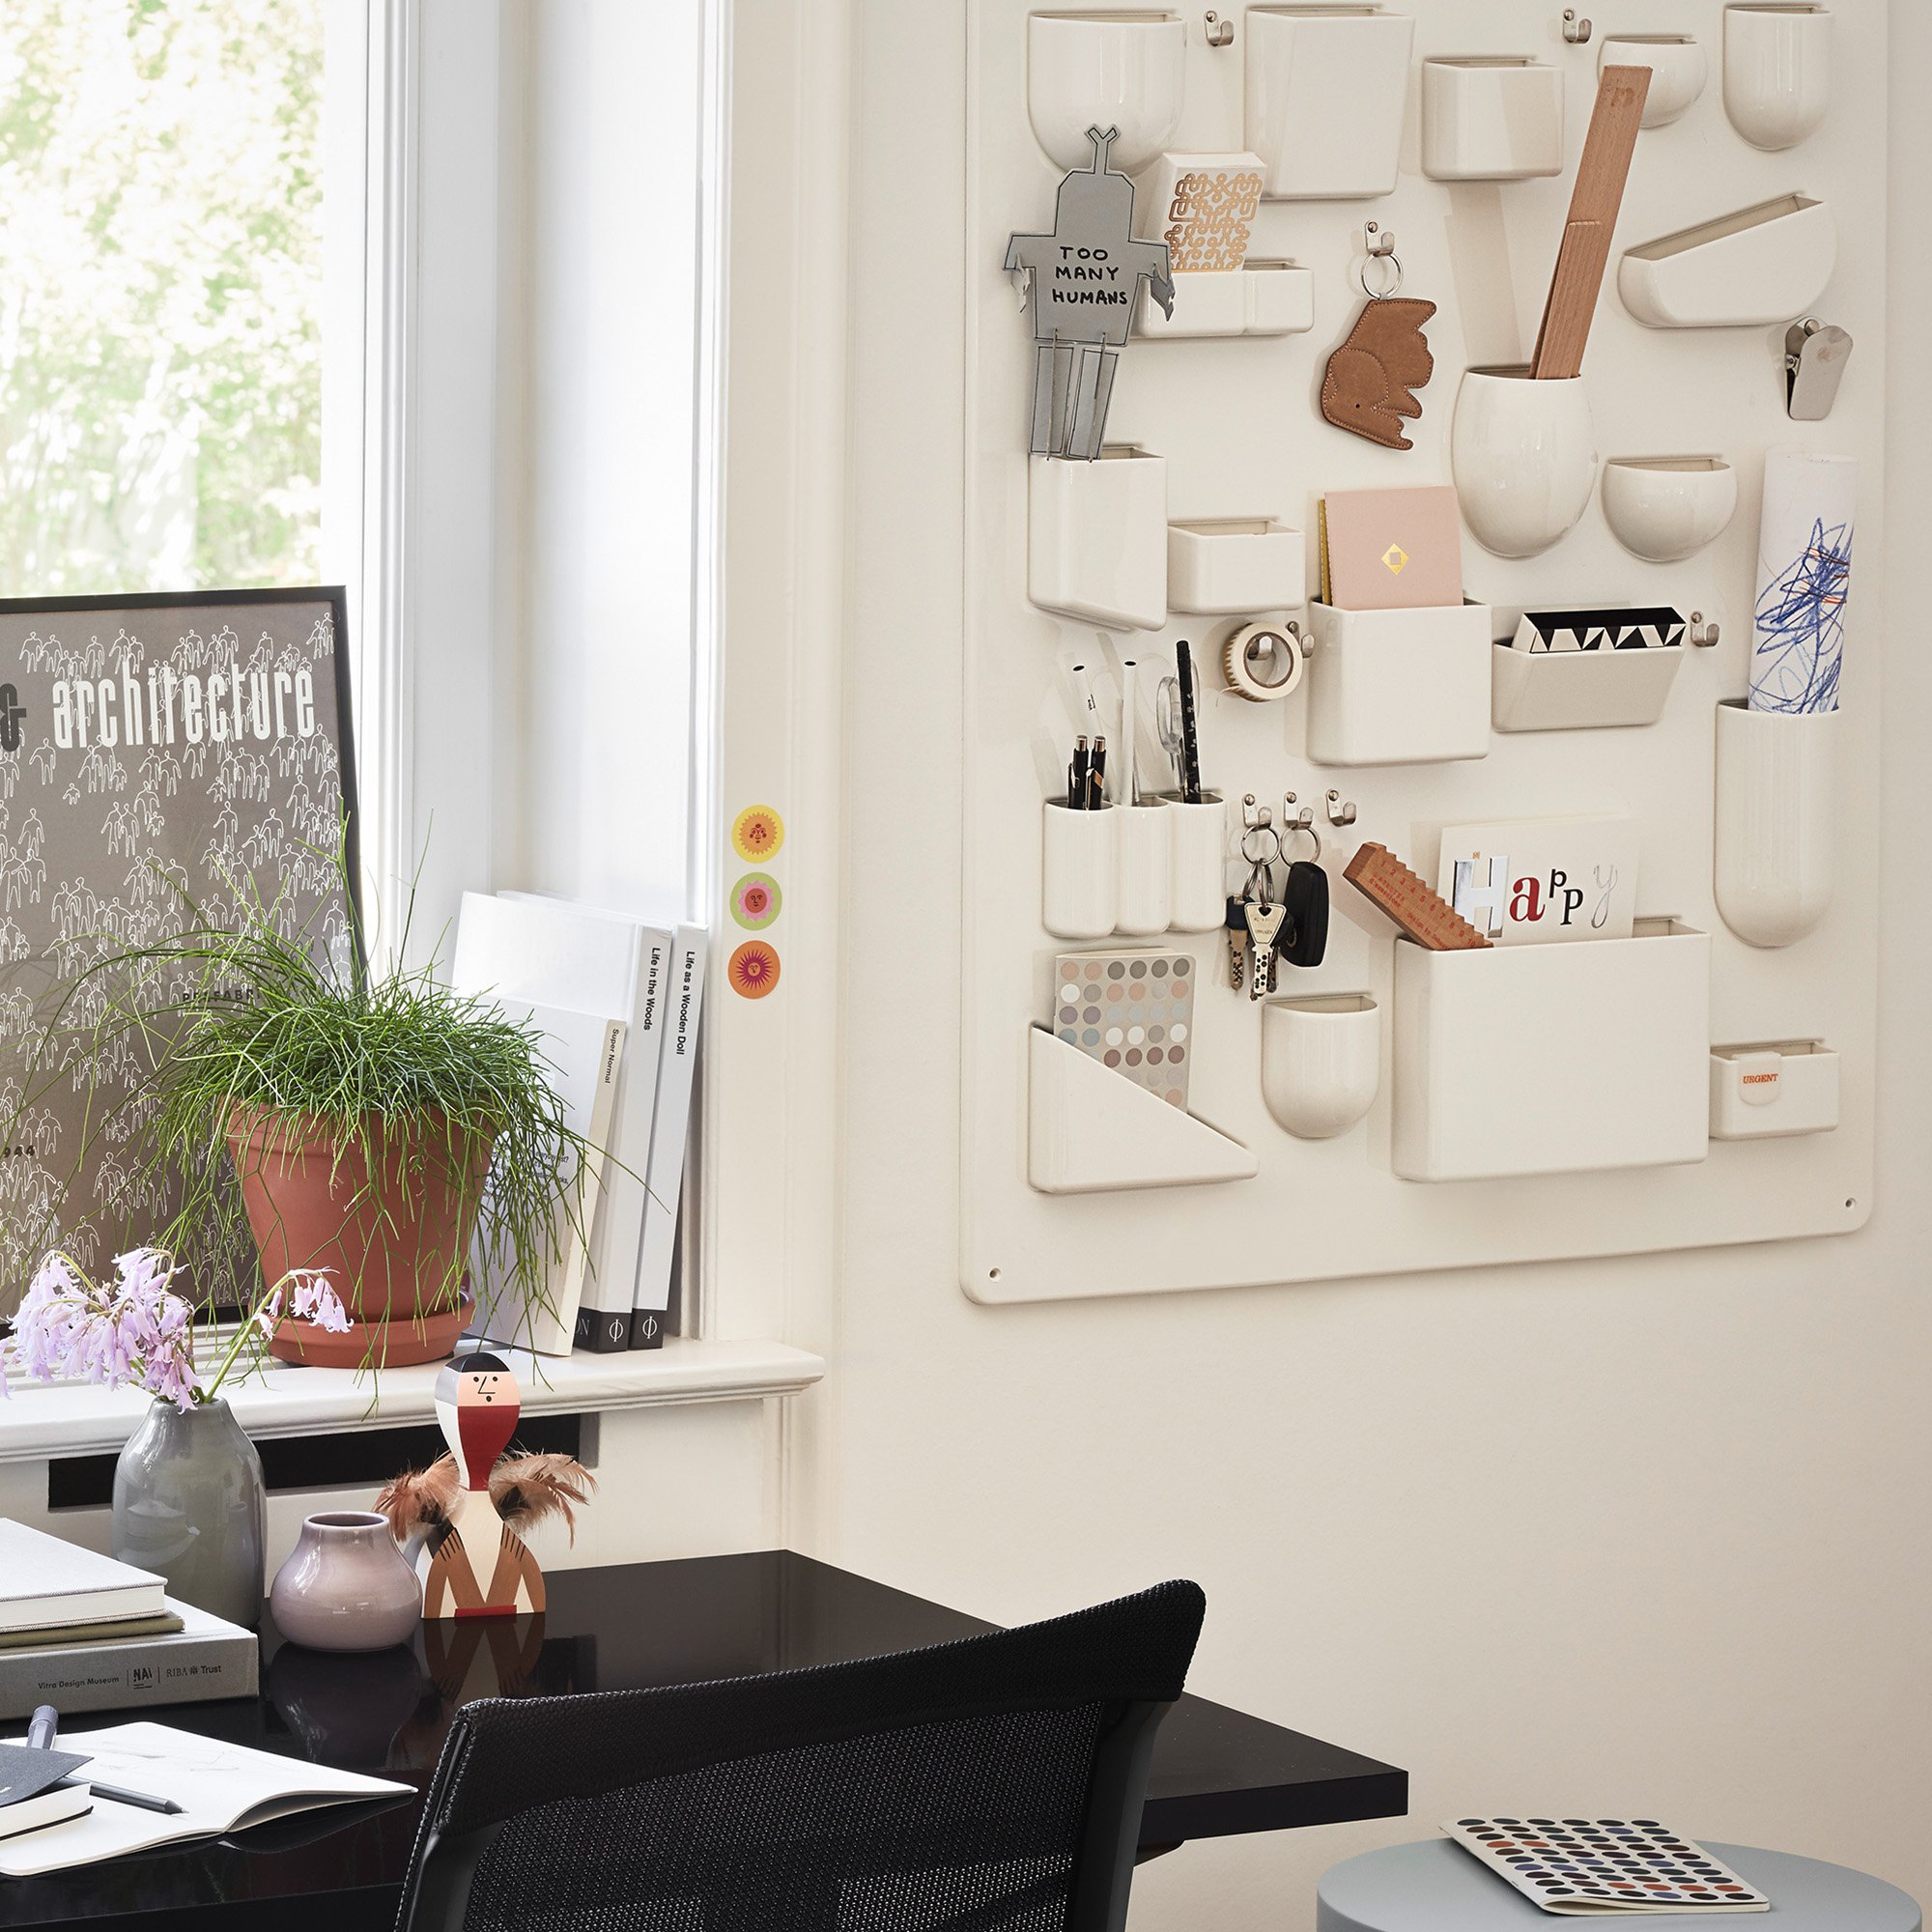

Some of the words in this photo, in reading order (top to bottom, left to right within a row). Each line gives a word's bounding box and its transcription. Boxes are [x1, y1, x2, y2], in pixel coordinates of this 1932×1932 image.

[1060, 246, 1108, 260] TOO
[1055, 266, 1119, 281] MANY
[1052, 288, 1128, 305] HUMANS
[52, 660, 315, 749] architecture
[1452, 855, 1618, 938] Happy
[1468, 938, 1476, 948] 10
[650, 948, 661, 966] Life
[684, 951, 696, 970] Life
[649, 968, 659, 978] in
[683, 972, 693, 983] as
[647, 979, 657, 996] the
[643, 998, 655, 1031] Woods
[678, 994, 691, 1034] Wooden
[611, 1028, 619, 1055] Super
[676, 1036, 687, 1055] Doll
[605, 1055, 615, 1084] Normal
[1743, 1073, 1778, 1084] URGENT
[166, 1667, 187, 1678] RIBA
[201, 1665, 221, 1674] Trust
[59, 1679, 85, 1689] Design
[87, 1676, 120, 1686] Museum
